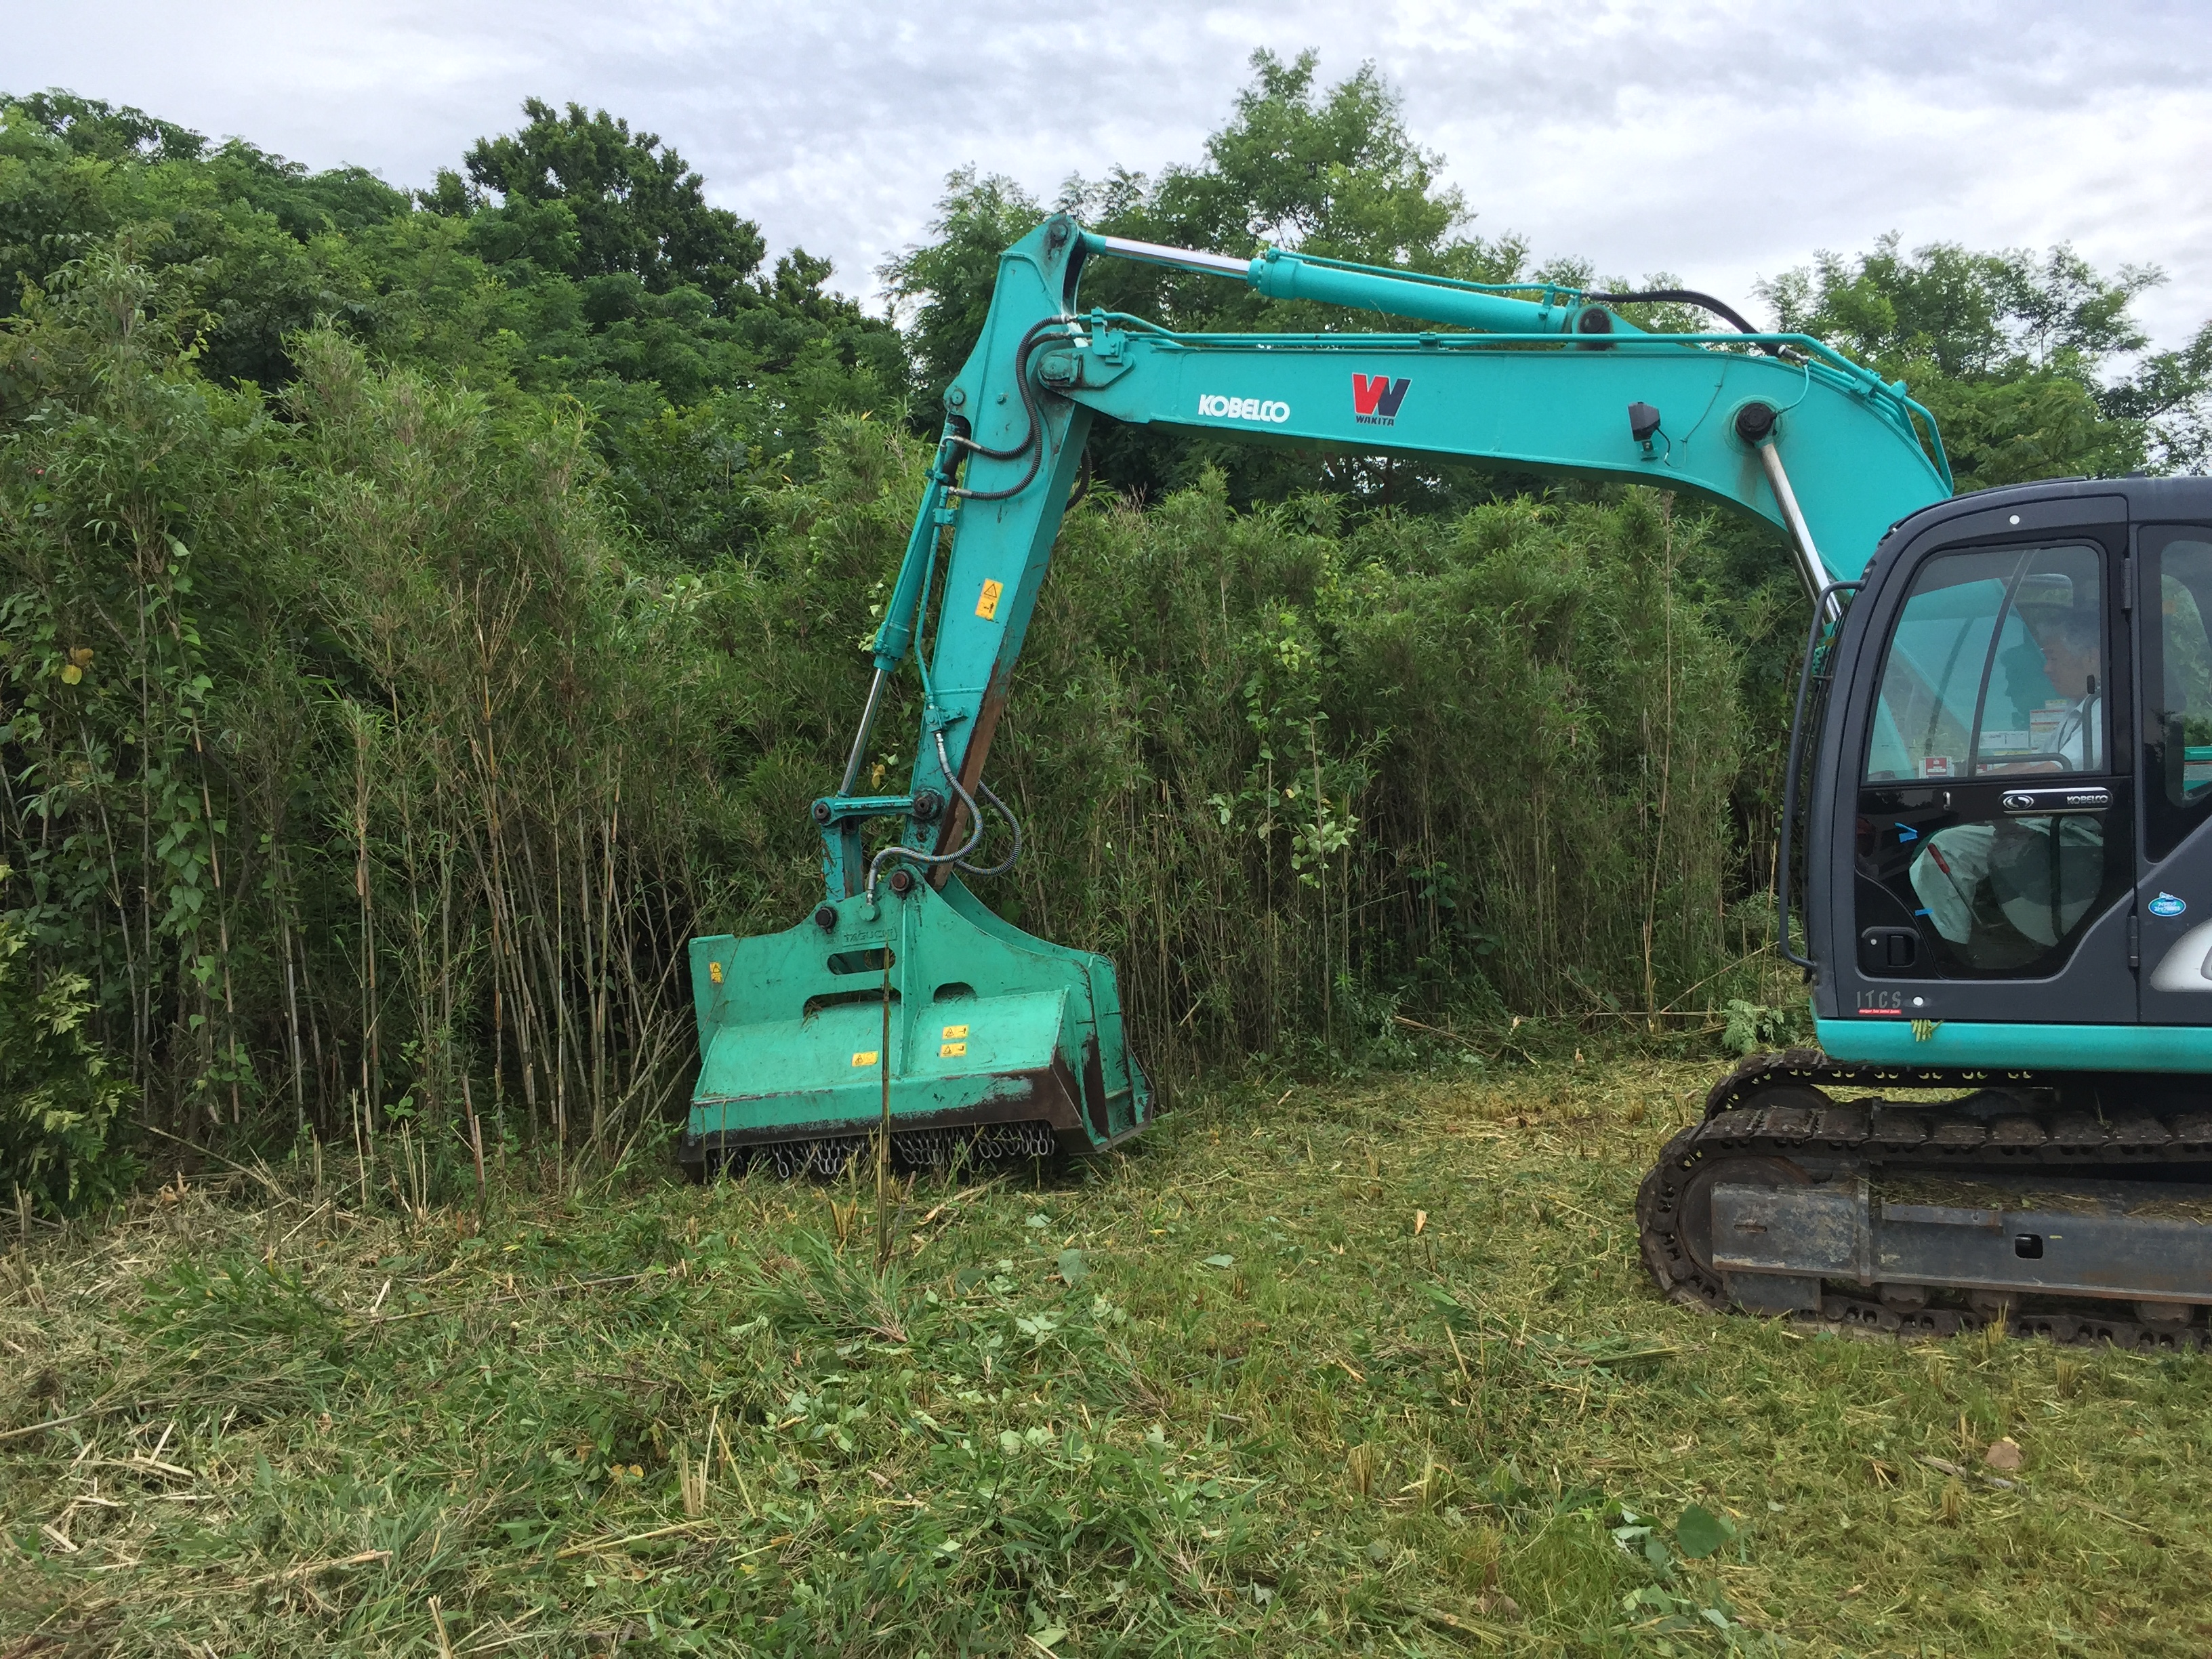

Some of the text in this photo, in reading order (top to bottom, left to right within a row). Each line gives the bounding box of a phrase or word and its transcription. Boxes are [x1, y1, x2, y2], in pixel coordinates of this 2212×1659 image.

[1198, 394, 1290, 424] KOBELCO
[1356, 415, 1395, 426] WAKITA
[2067, 795, 2108, 805] KOBELCO
[1857, 990, 1901, 1008] ITCS
